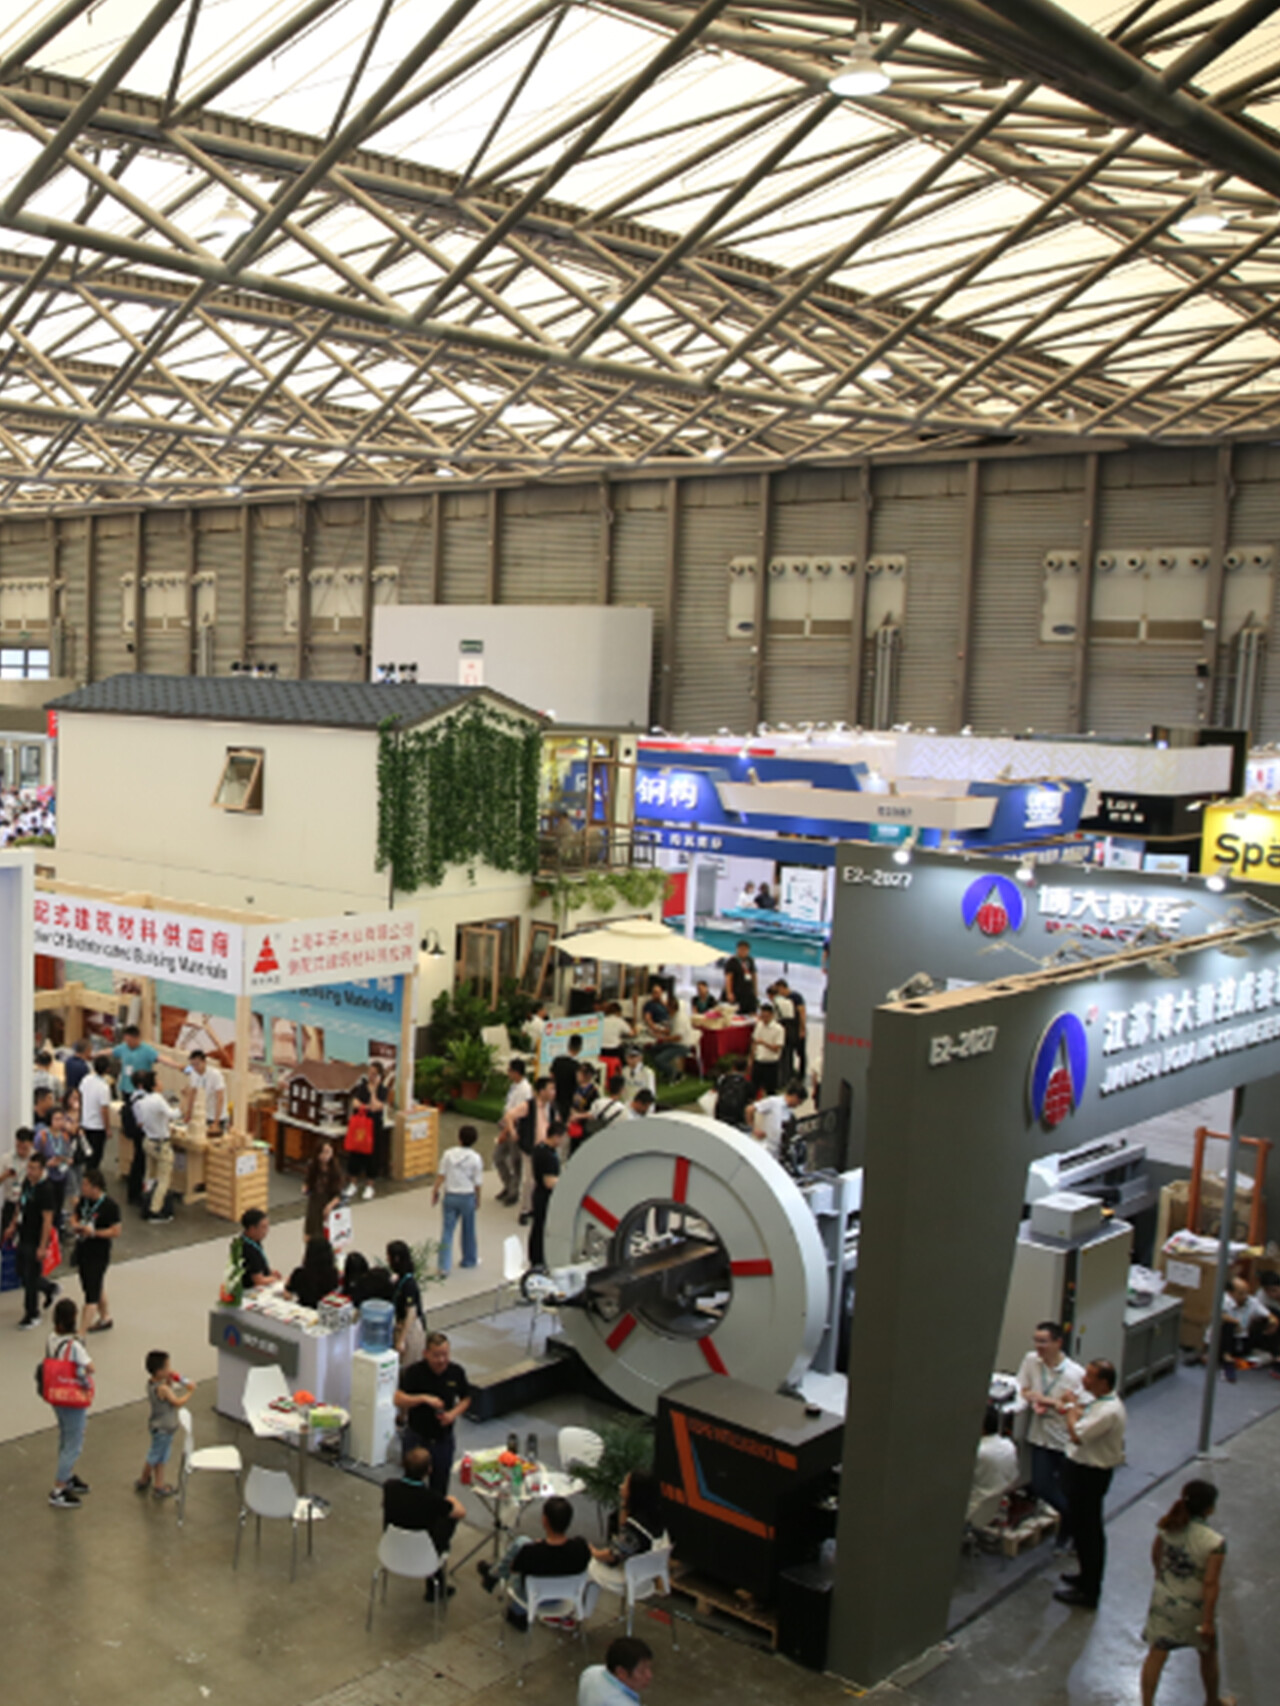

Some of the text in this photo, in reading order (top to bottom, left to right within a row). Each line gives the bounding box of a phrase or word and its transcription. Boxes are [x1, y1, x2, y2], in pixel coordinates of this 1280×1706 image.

[637, 776, 699, 809] 钢构
[843, 866, 912, 888] E2-2027
[34, 899, 228, 958] 配式建筑材料供应商
[930, 1026, 998, 1066] E2-2027
